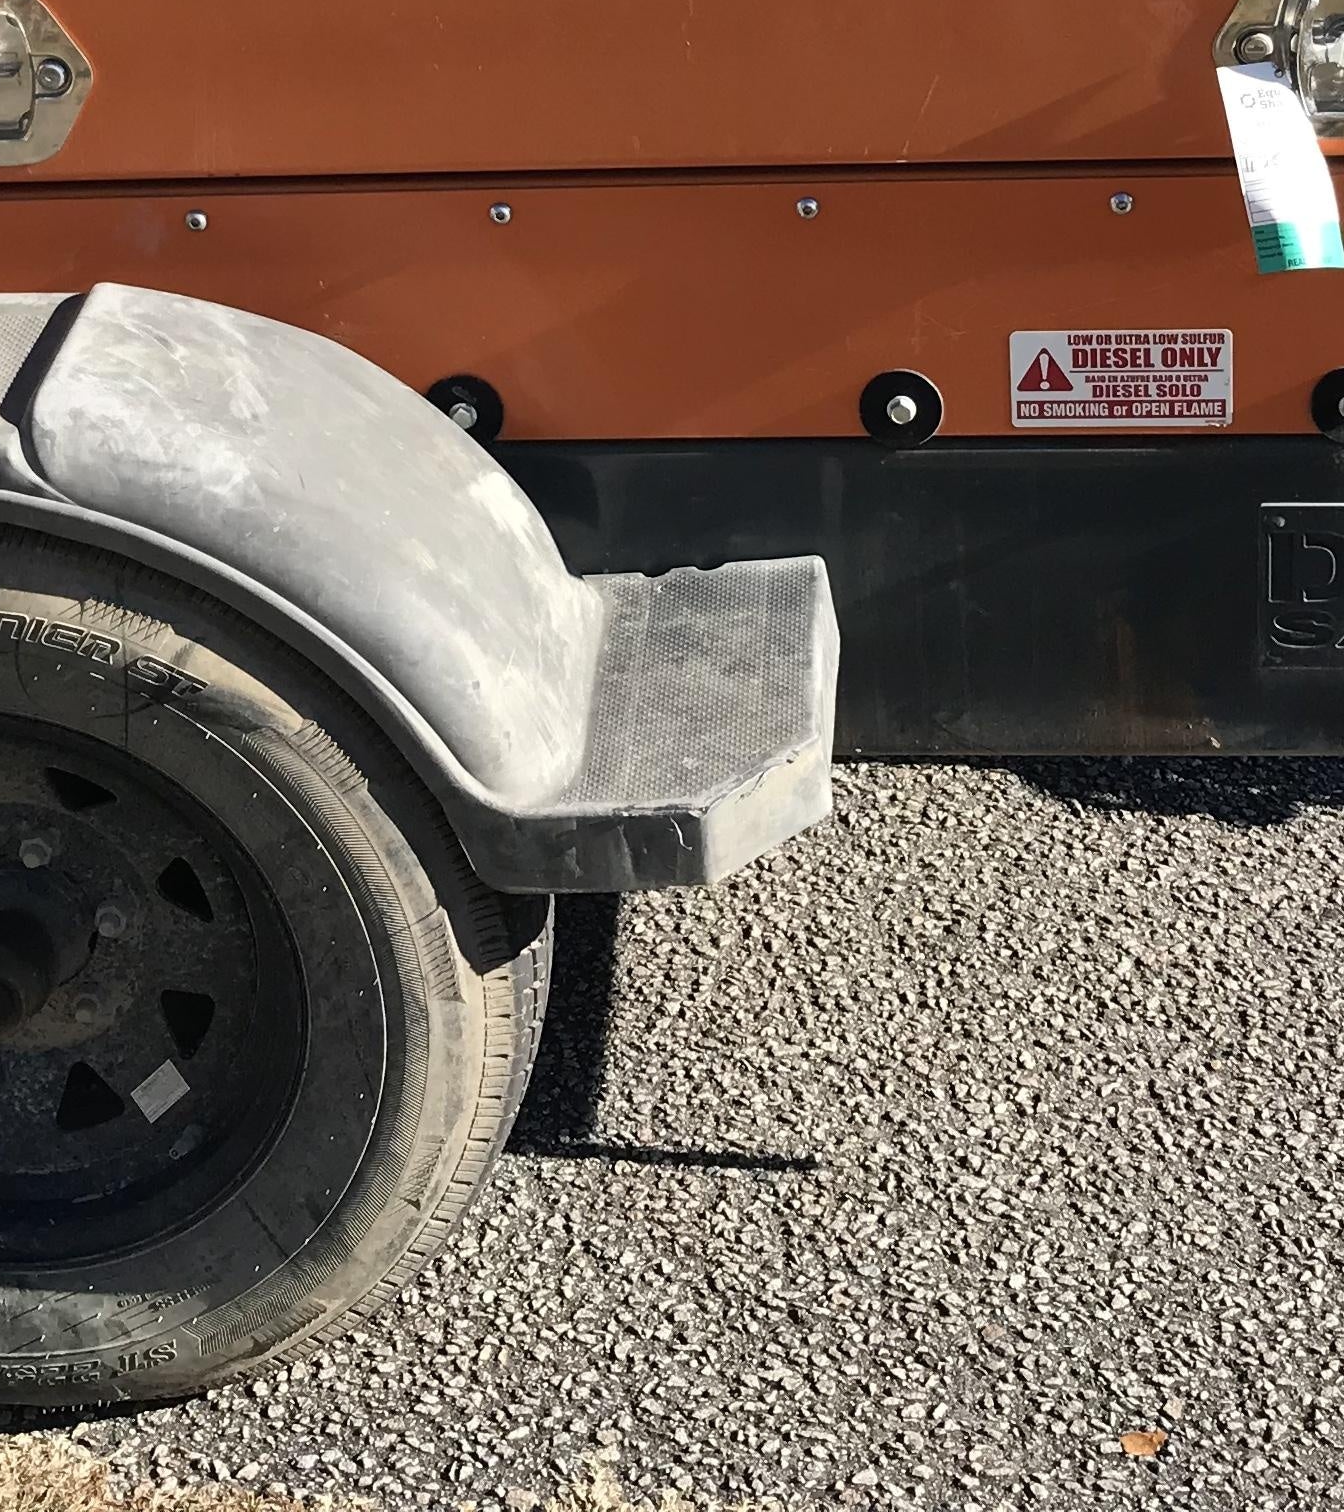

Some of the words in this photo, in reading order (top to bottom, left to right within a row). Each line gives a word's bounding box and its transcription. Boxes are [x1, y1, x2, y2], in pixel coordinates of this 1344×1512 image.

[1068, 334, 1094, 346] LOW
[1096, 334, 1112, 346] OR
[1114, 334, 1150, 345] ULTRA
[1152, 333, 1179, 345] LOW
[1180, 332, 1226, 344] SULFUR
[1072, 348, 1156, 368] DIESEL
[1160, 346, 1222, 368] ONLY
[1084, 375, 1106, 383] BAJO
[1108, 375, 1118, 383] EN
[1119, 374, 1150, 382] AZUFRE
[1152, 374, 1173, 382] BAJO
[1182, 374, 1209, 382] ULTRA
[1092, 384, 1152, 398] DIESEL
[1156, 384, 1202, 398] SOLO
[1020, 403, 1040, 416] NO
[1043, 402, 1109, 416] SMOKING
[1113, 405, 1128, 416] or
[1132, 402, 1170, 416] OPEN
[1174, 402, 1223, 416] FLAME
[127, 654, 210, 697] ST
